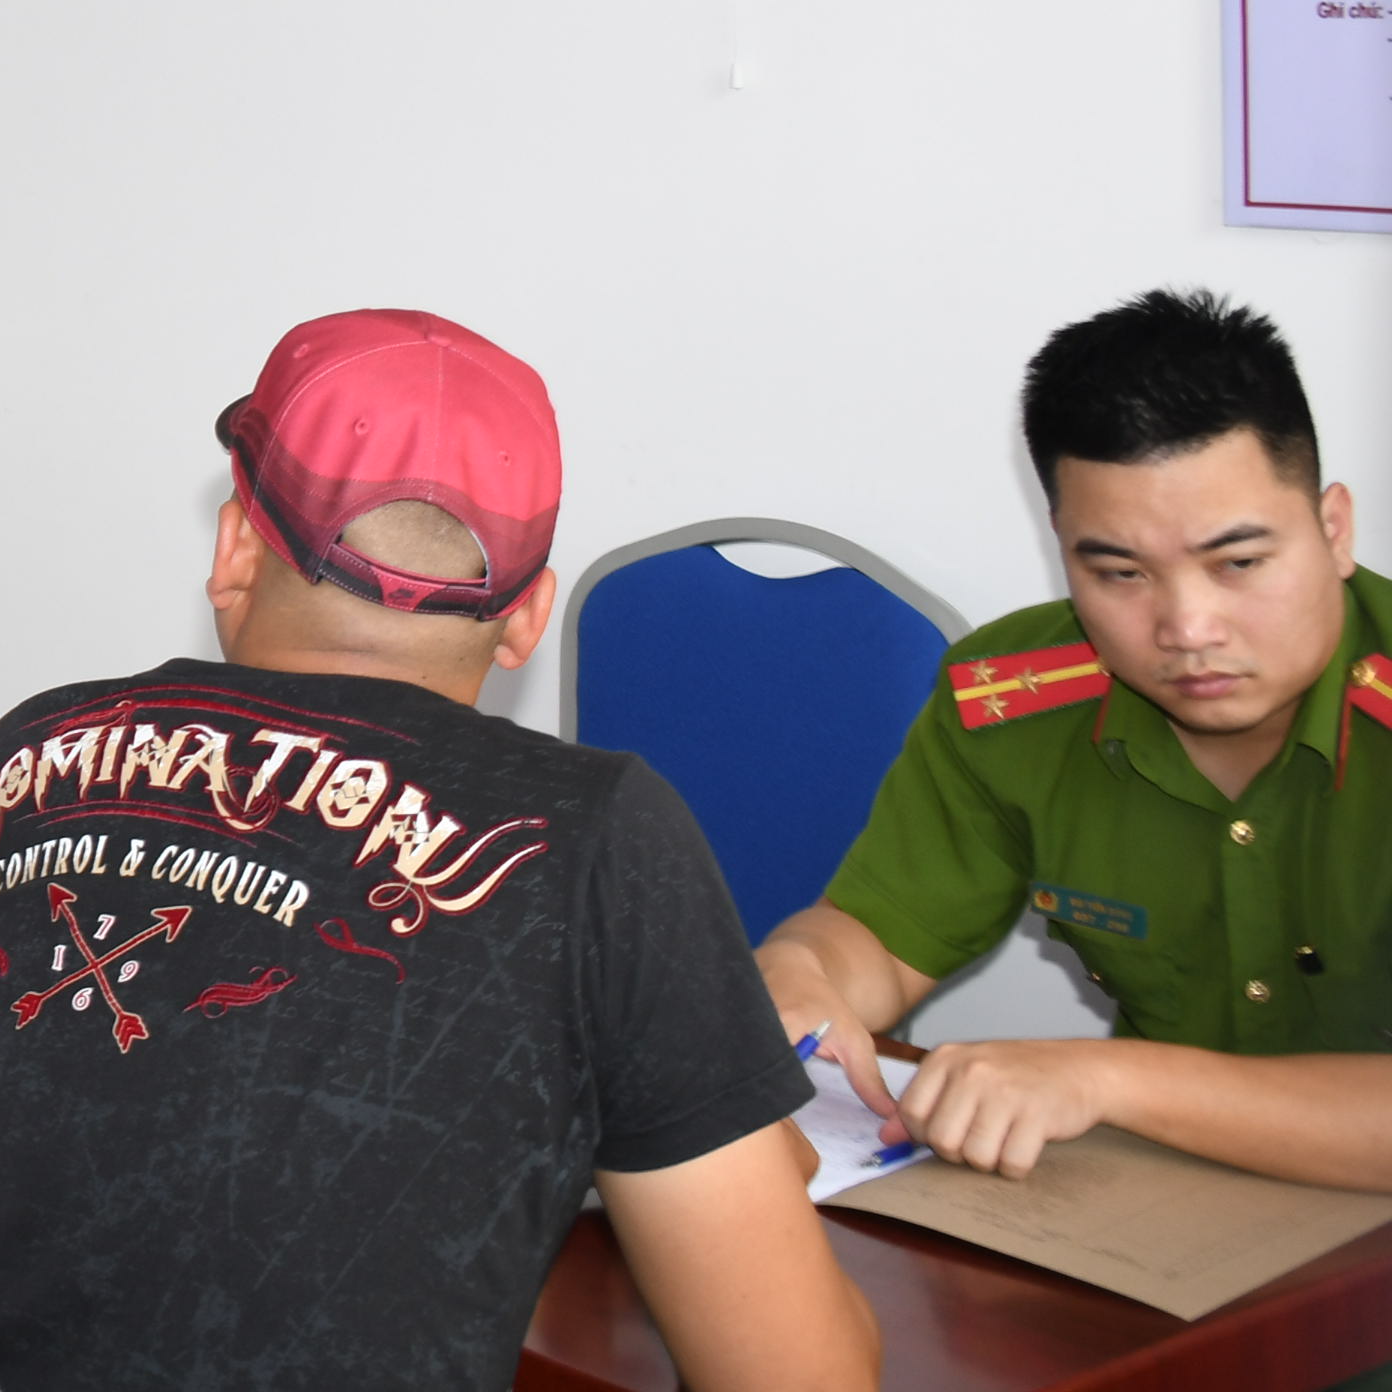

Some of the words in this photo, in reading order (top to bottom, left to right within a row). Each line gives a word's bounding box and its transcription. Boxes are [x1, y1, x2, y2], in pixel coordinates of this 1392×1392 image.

[1316, 2, 1346, 19] Ghi
[119, 838, 146, 877] &
[150, 844, 311, 928] CONQUER
[92, 914, 116, 941] 7
[116, 960, 141, 983] 9
[71, 987, 94, 1011] 6
